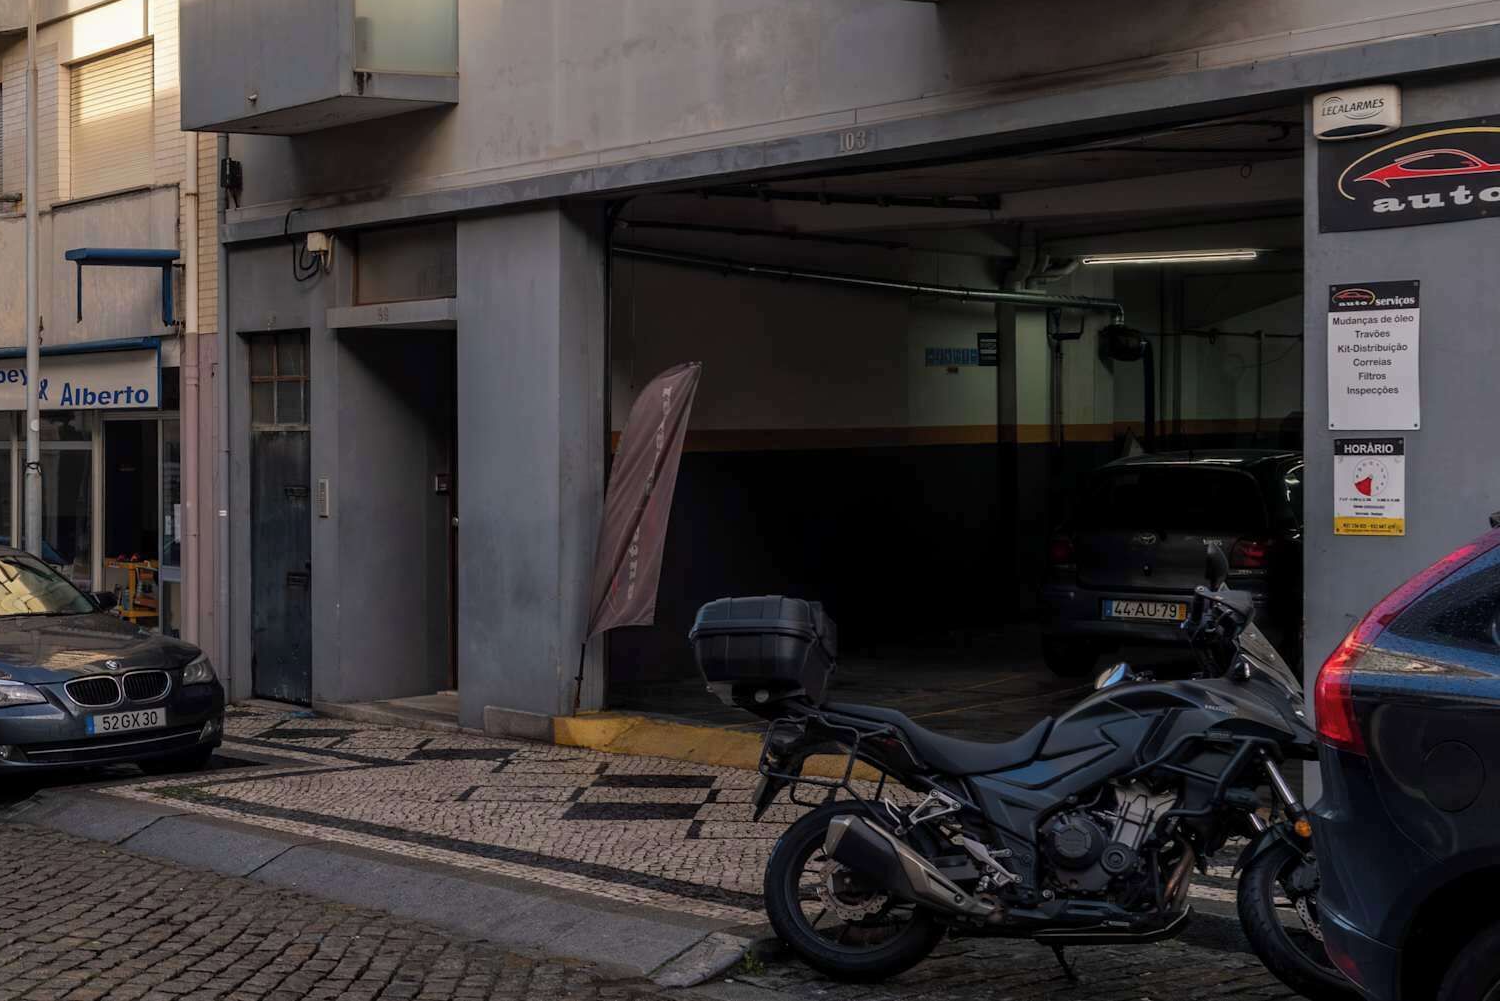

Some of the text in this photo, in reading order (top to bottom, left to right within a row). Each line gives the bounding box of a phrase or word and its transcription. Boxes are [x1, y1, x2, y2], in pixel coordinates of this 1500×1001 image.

[1322, 98, 1384, 117] LECALARMES
[1373, 185, 1500, 213] auto
[1375, 295, 1415, 307] serviços
[1332, 314, 1414, 325] Mudanças de óleo
[1355, 329, 1390, 338] Travões
[1352, 358, 1392, 367] Correias
[1358, 372, 1387, 381] Filtros
[60, 382, 149, 406] Alberto
[1347, 386, 1399, 396] Inspecções
[1344, 442, 1394, 454] HORÁRIO
